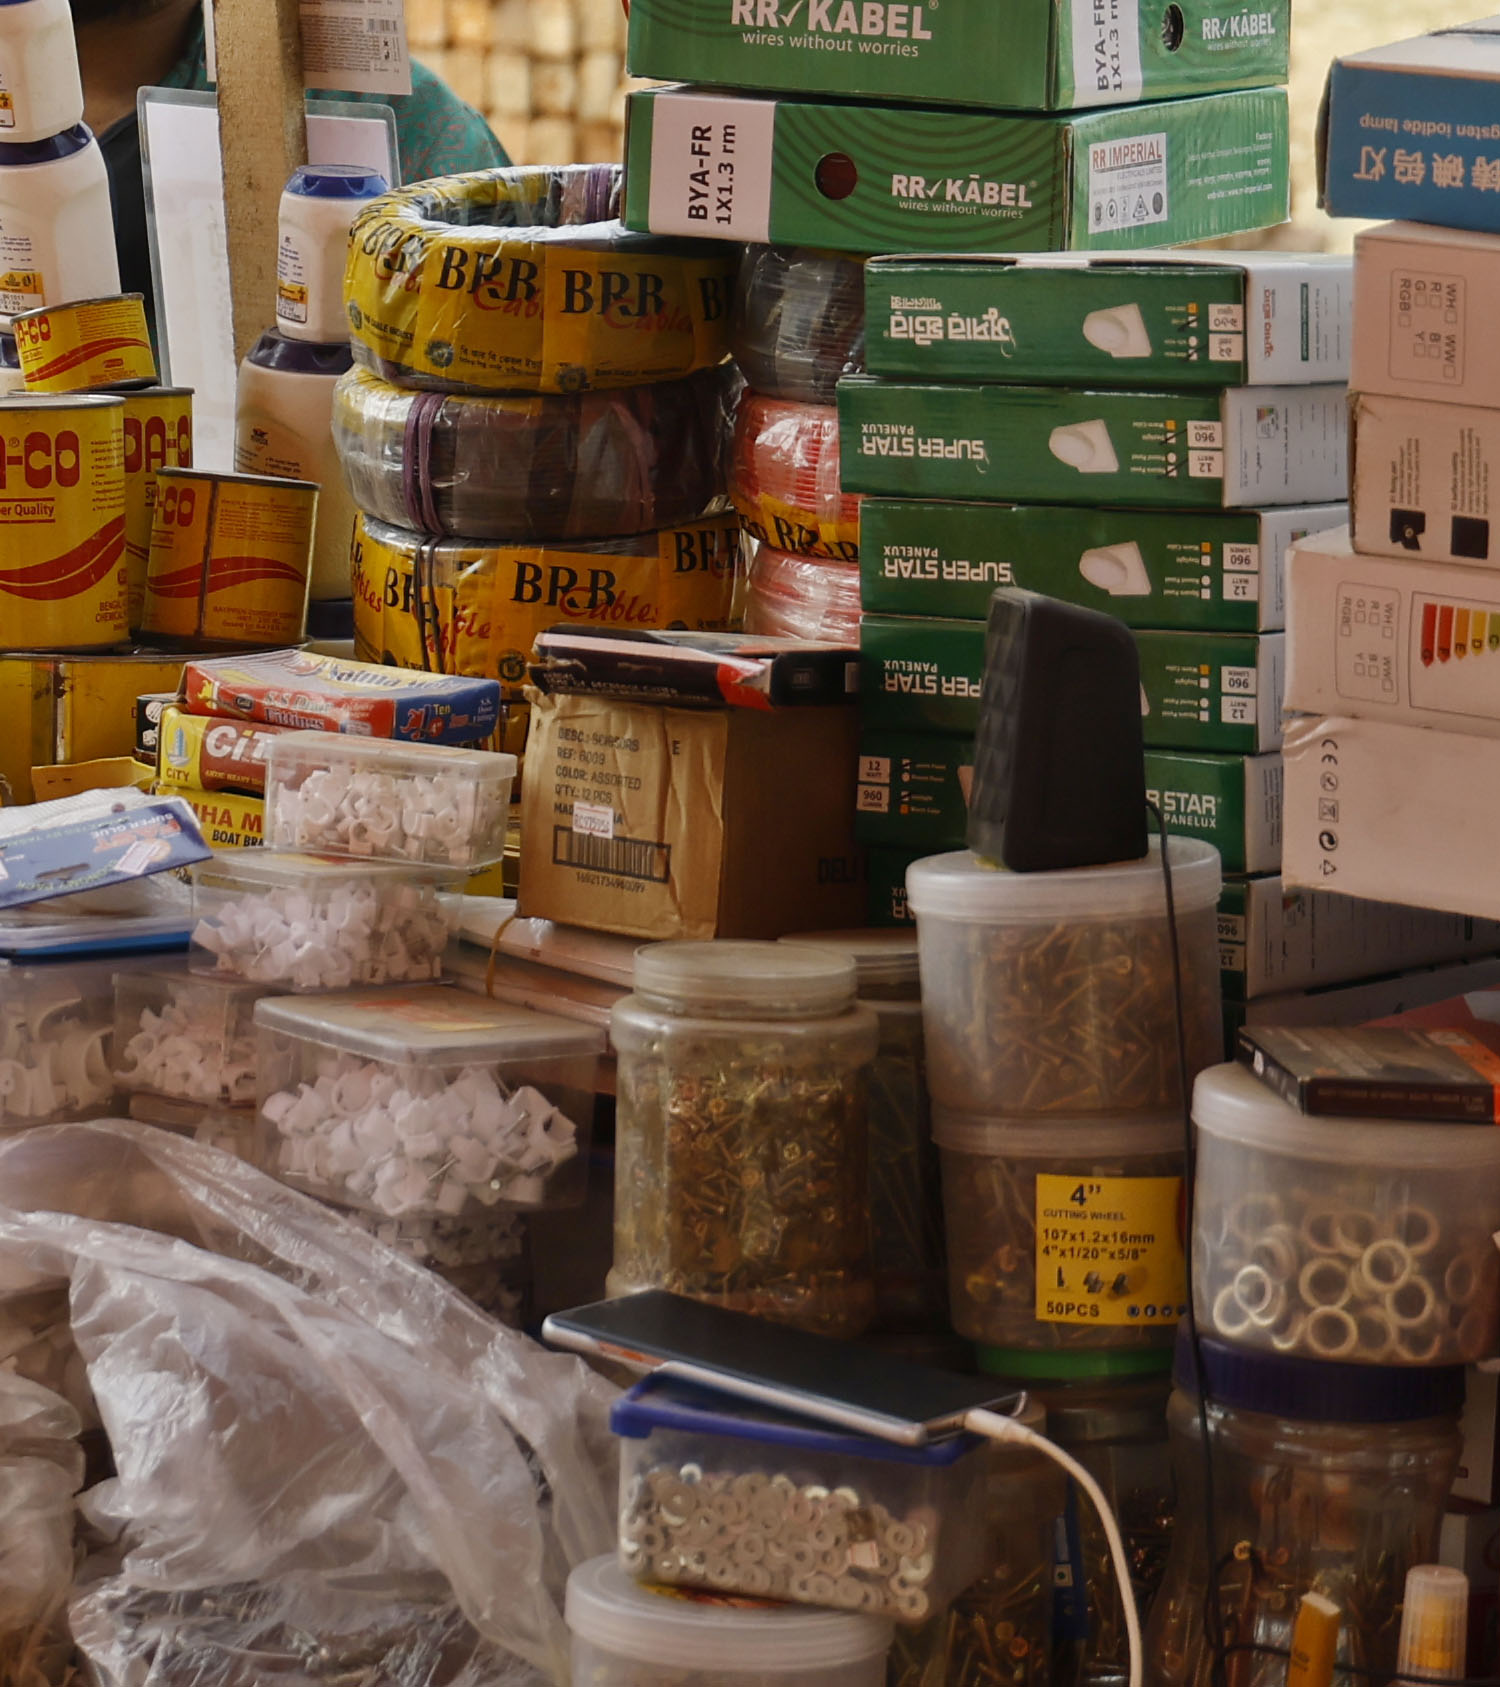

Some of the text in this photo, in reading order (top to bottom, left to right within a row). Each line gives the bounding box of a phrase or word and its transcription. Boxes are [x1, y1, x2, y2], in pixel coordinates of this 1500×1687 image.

[742, 31, 920, 58] wires without worries
[1359, 115, 1400, 134] lamp
[1092, 136, 1163, 170] RR IMPERIAL
[688, 123, 713, 221] BYA-FR
[715, 123, 737, 226] 1X1.3 rm
[891, 172, 1032, 210] RR KĀBEL
[898, 199, 1024, 220] wires without worries
[861, 422, 915, 435] PANELUX
[861, 434, 986, 460] SUPER STAR
[13, 501, 56, 517] Quality
[883, 544, 939, 559] PANELUX
[1230, 554, 1252, 567] 960
[883, 557, 1012, 583] SUPER STAR
[511, 559, 617, 611] BRB
[1232, 583, 1248, 597] 12
[1227, 676, 1250, 689] 960
[556, 764, 642, 791] COLOR: ASSORTED
[1043, 1208, 1127, 1222] CUTTING WHEEL
[1043, 1227, 1156, 1245] 107x1.2x16mm
[1046, 1300, 1100, 1317] 50PCS
